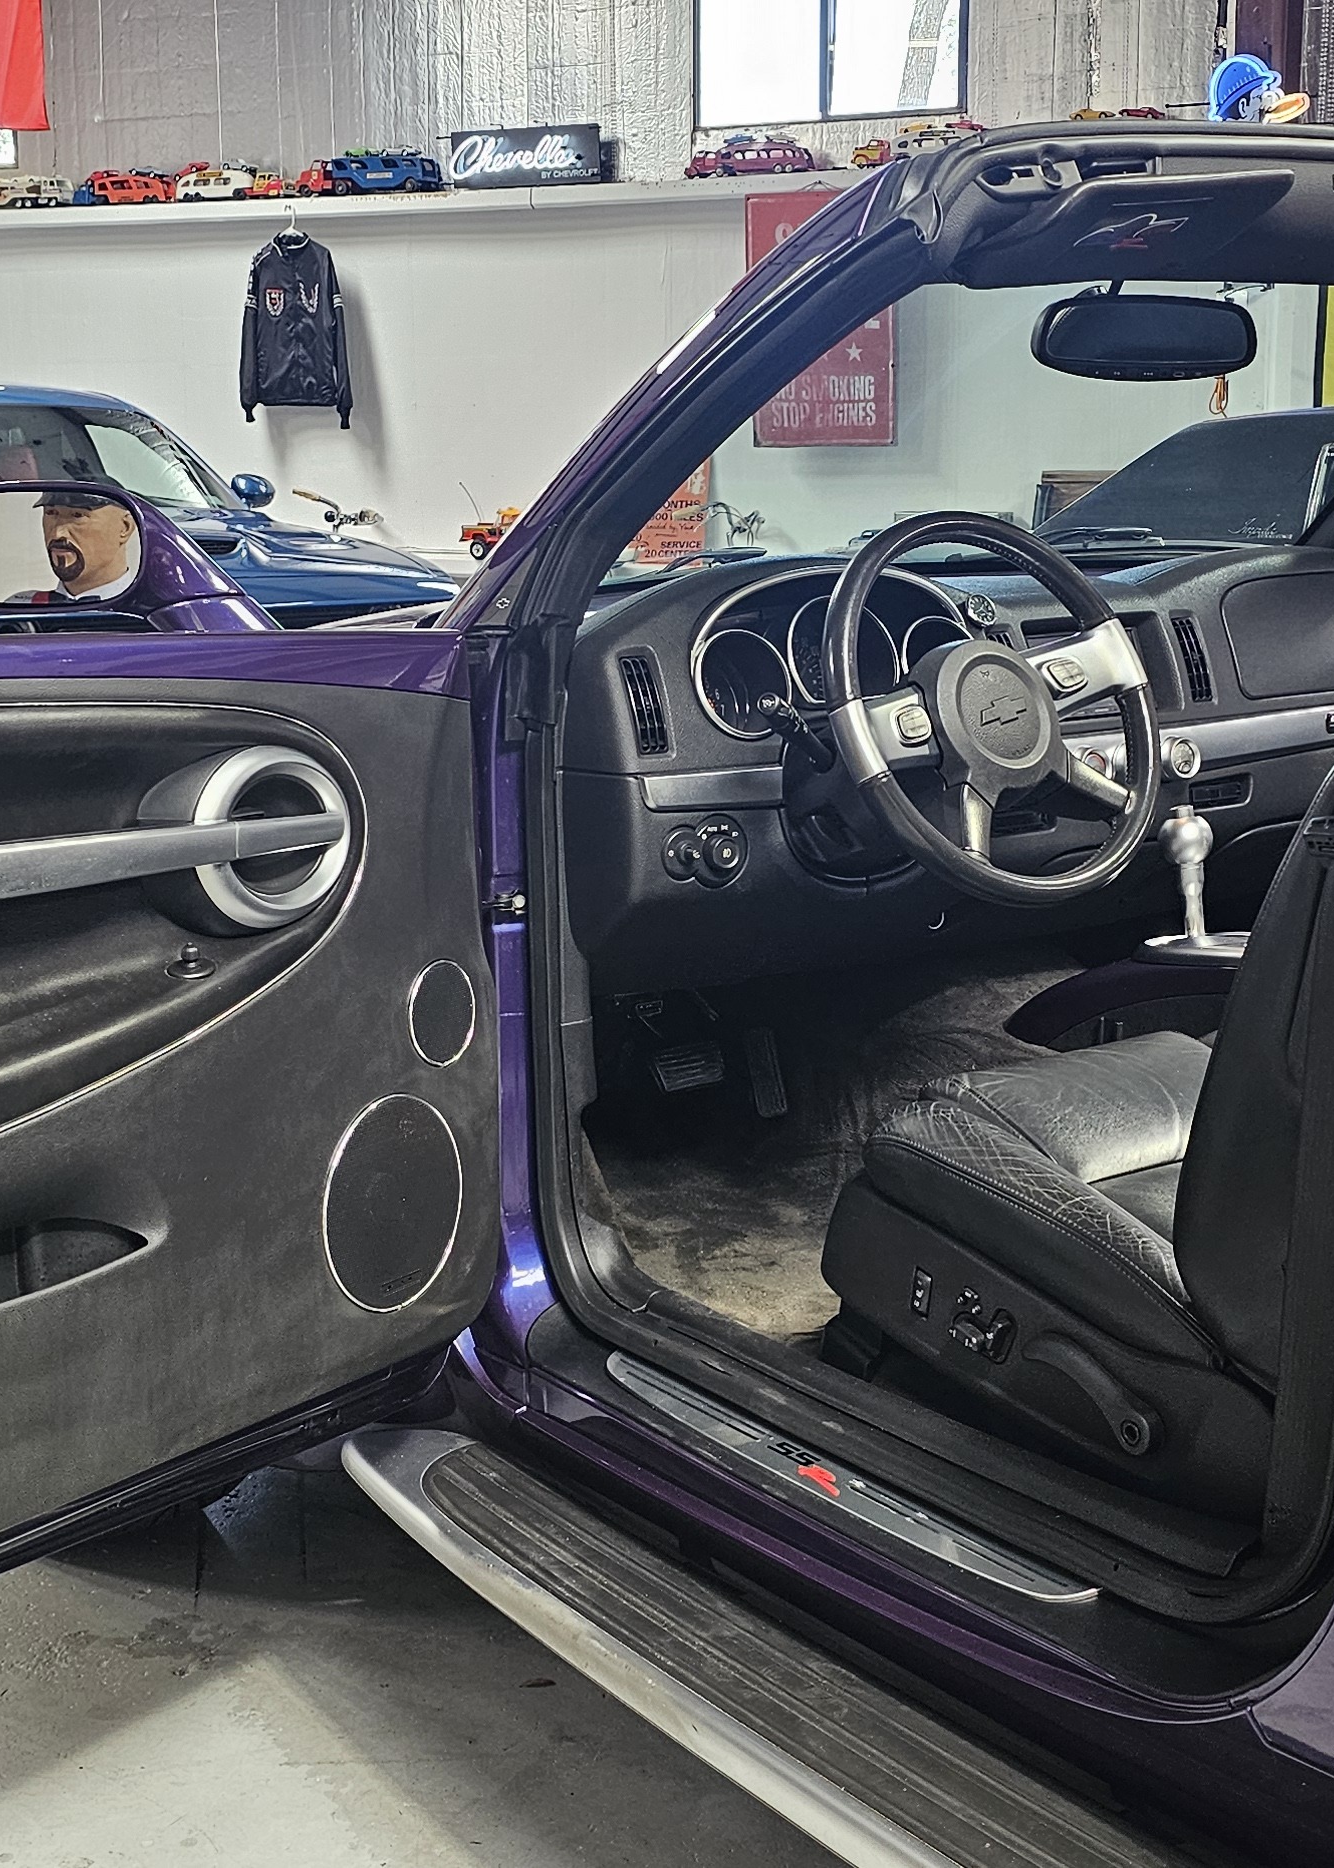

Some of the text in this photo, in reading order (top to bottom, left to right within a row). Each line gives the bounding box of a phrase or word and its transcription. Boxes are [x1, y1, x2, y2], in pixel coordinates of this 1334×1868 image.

[449, 134, 579, 180] Chevelle
[541, 170, 552, 179] BY
[802, 374, 875, 400] SMOKING
[771, 401, 876, 428] STOP ENGINES
[663, 499, 701, 510] ONTHS
[661, 540, 703, 549] SERVICE
[645, 549, 657, 558] 20
